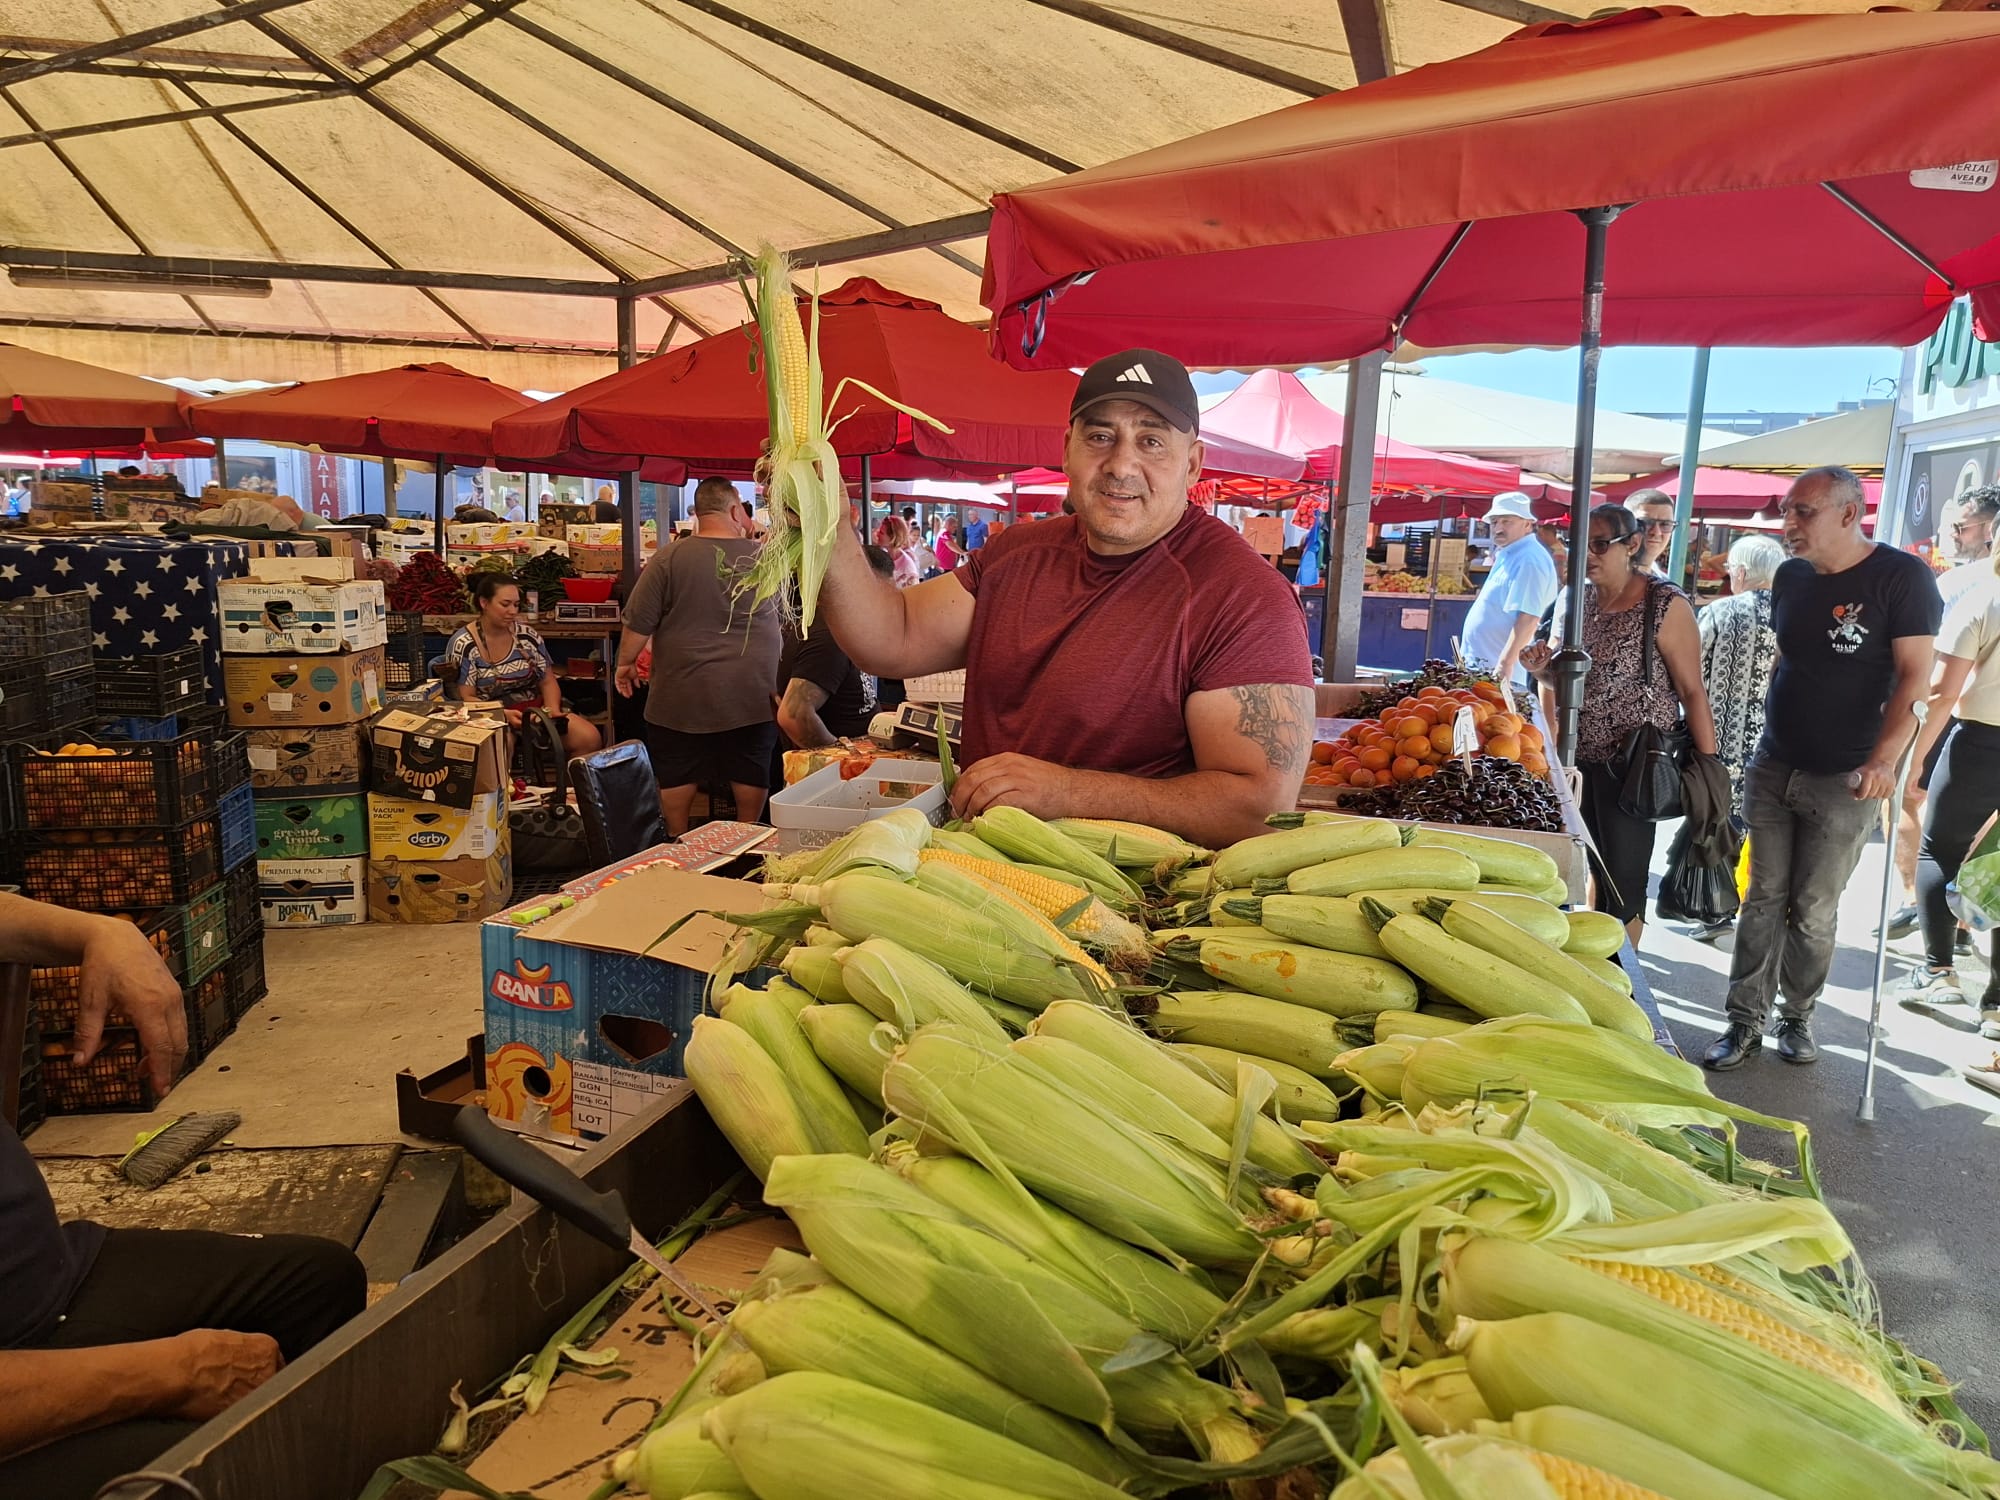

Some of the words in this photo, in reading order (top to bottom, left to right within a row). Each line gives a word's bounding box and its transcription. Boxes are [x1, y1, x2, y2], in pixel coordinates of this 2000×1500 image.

[265, 631, 296, 645] BONITA
[273, 828, 312, 840] green
[410, 833, 448, 846] derby
[277, 904, 318, 922] BONITA
[578, 1113, 603, 1126] LOT
